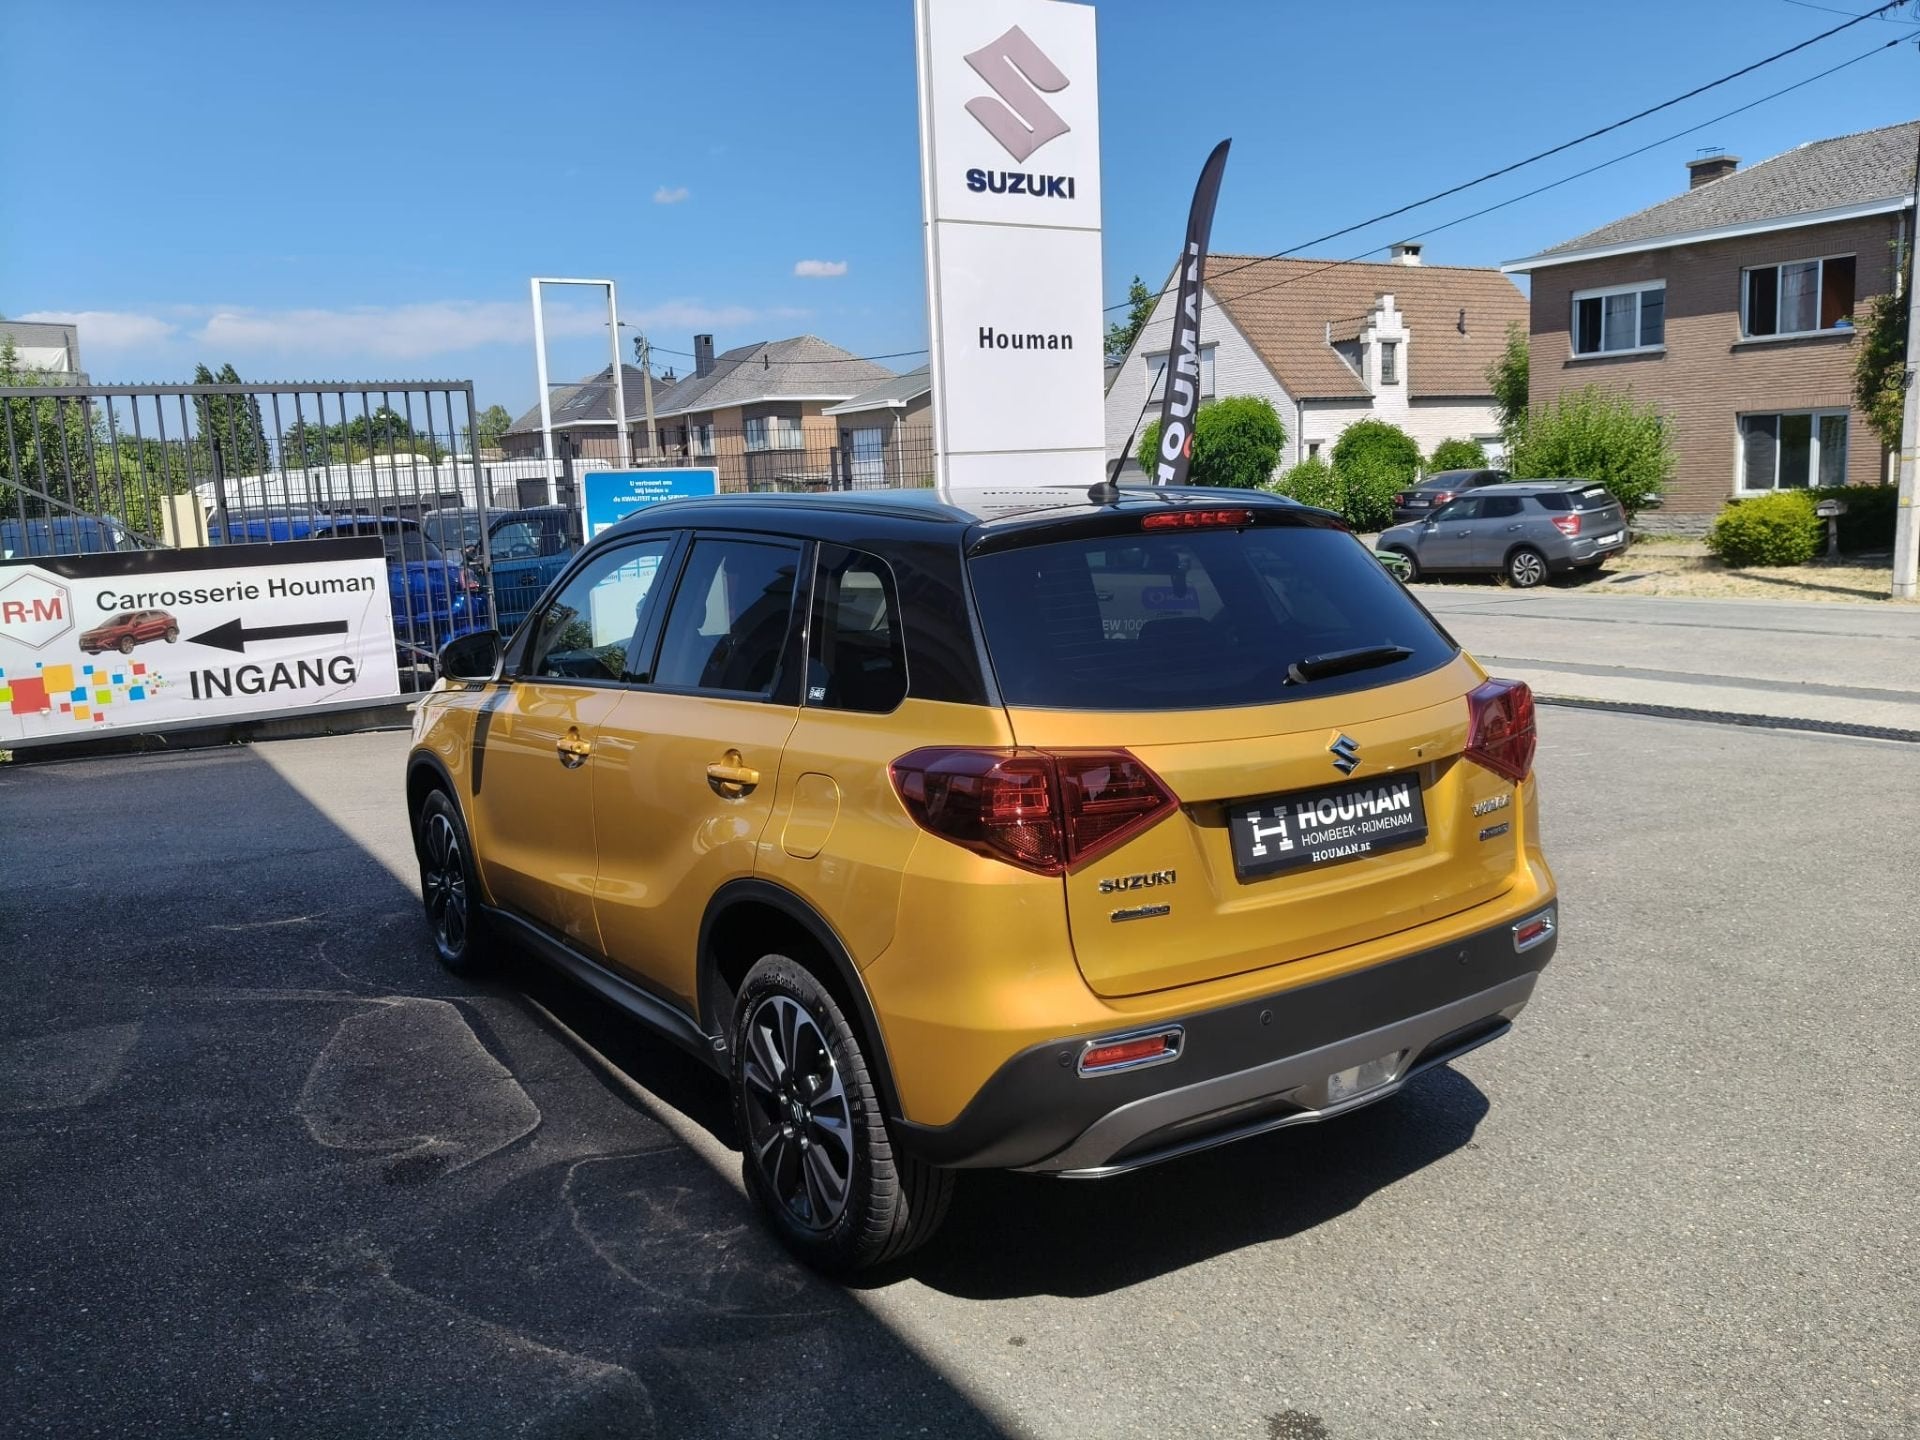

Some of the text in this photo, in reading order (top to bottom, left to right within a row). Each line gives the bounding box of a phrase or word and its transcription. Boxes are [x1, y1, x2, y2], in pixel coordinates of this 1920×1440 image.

[966, 168, 1075, 199] SUZUKI
[979, 327, 1073, 350] Houman
[97, 574, 376, 611] Carrosserie Houman
[3, 598, 62, 624] R-M
[190, 655, 356, 700] INGANG
[1296, 783, 1410, 829] HOUMAN
[1301, 813, 1412, 847] HOMBEEK RIJMENAM
[1312, 842, 1371, 862] HOUMAN.BE
[1098, 869, 1176, 894] SUZUKI
